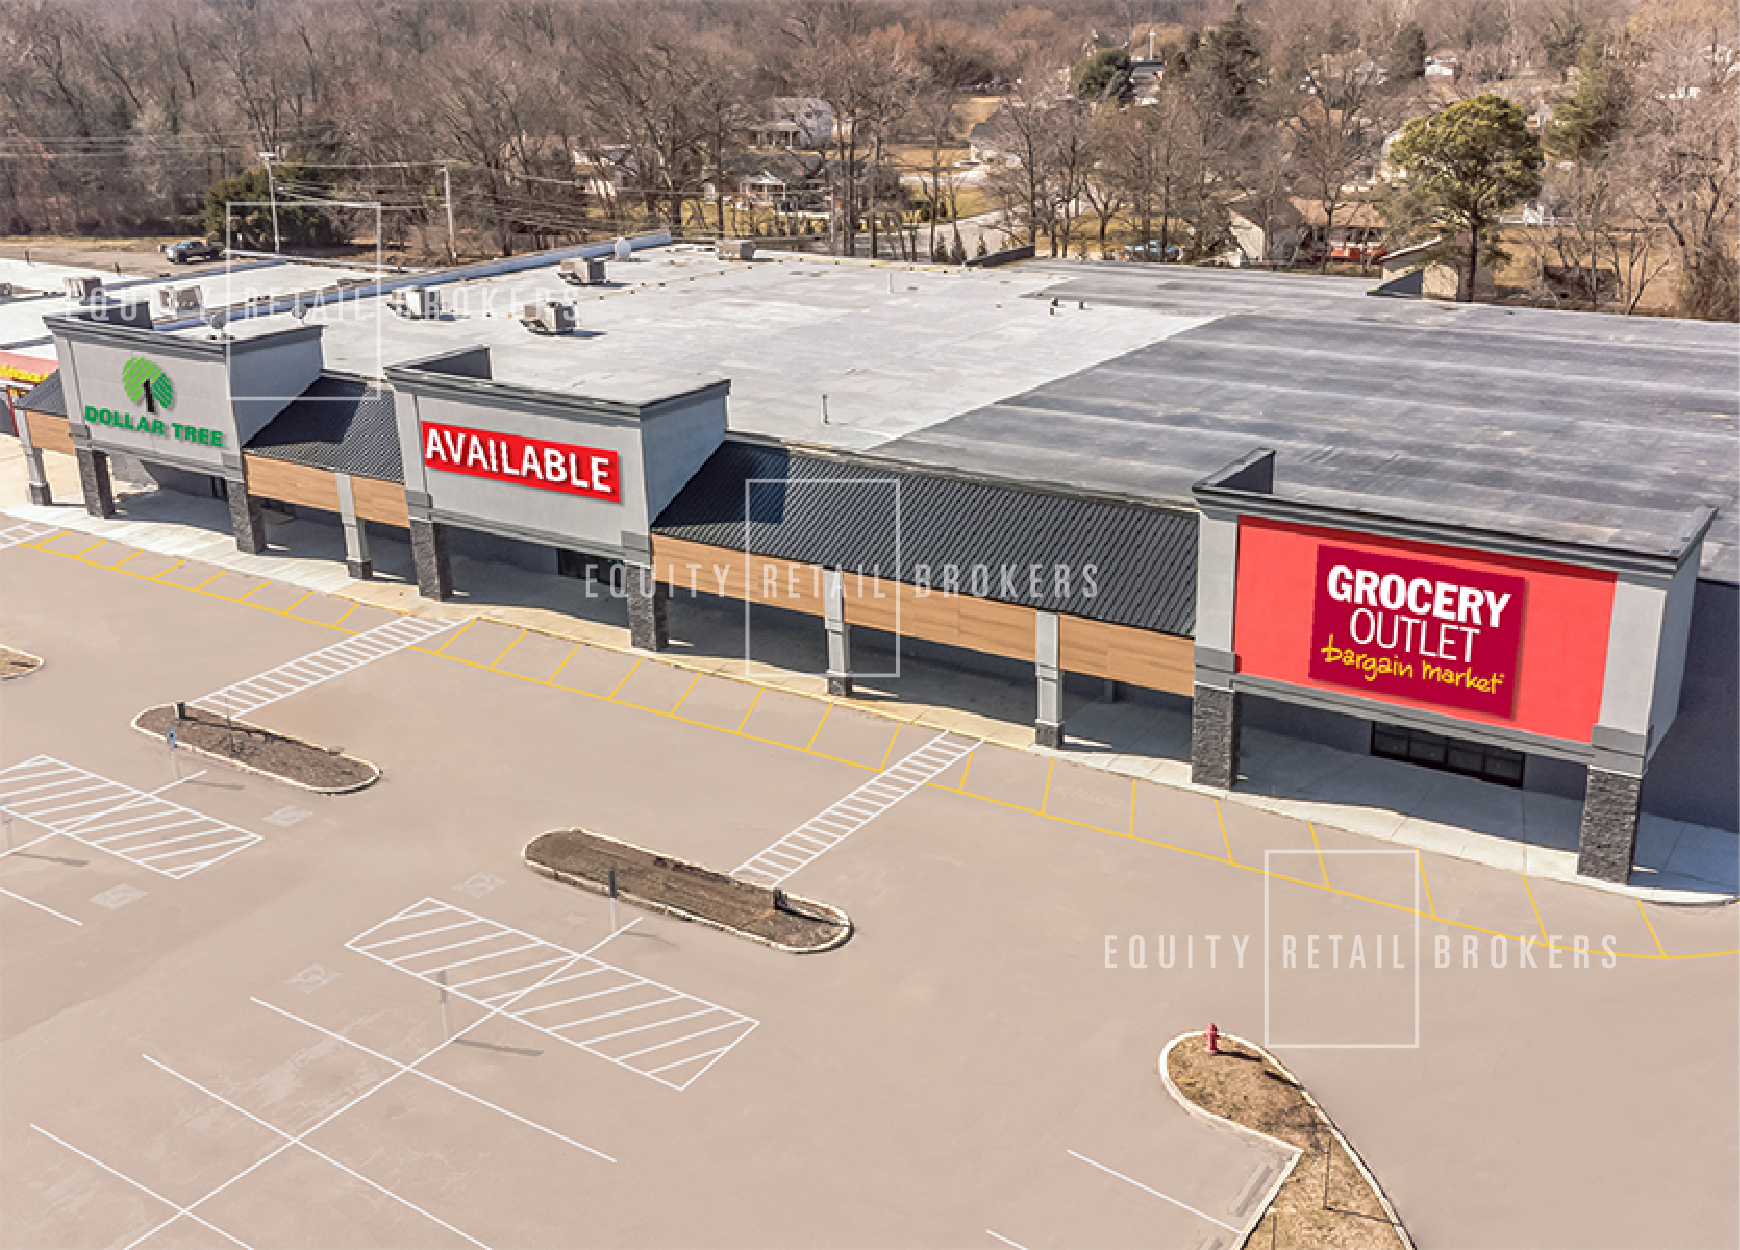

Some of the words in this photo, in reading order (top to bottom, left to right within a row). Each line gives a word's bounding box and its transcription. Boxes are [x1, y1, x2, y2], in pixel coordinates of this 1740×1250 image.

[84, 405, 168, 438] DOLLAR
[171, 422, 225, 448] TREE
[424, 427, 613, 494] AVAILABLE
[1326, 564, 1513, 628] GROCERY
[1320, 632, 1415, 682] bargain
[1421, 659, 1503, 695] market
[1349, 607, 1482, 663] OUTLET
